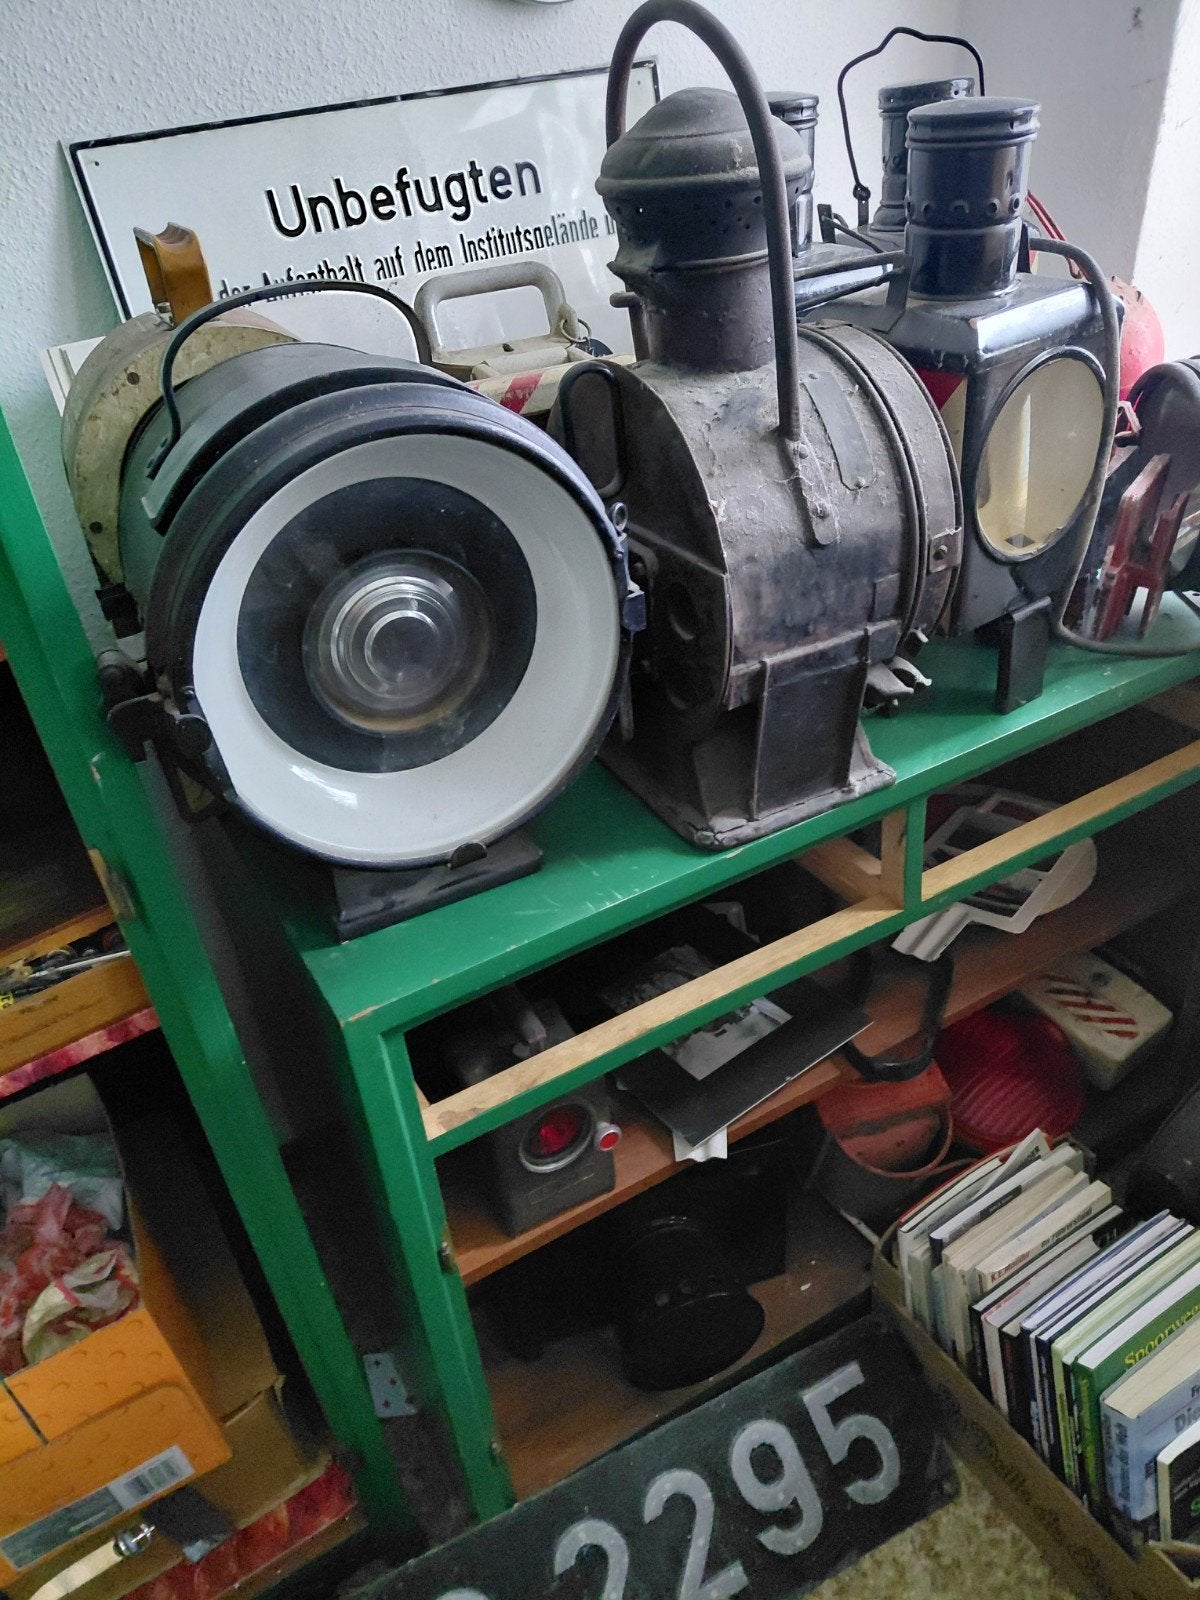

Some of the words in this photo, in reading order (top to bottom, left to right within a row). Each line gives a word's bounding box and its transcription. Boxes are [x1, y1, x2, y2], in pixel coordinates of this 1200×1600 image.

[265, 158, 541, 238] Unbefugten
[374, 245, 405, 281] auf
[414, 241, 453, 273] dem
